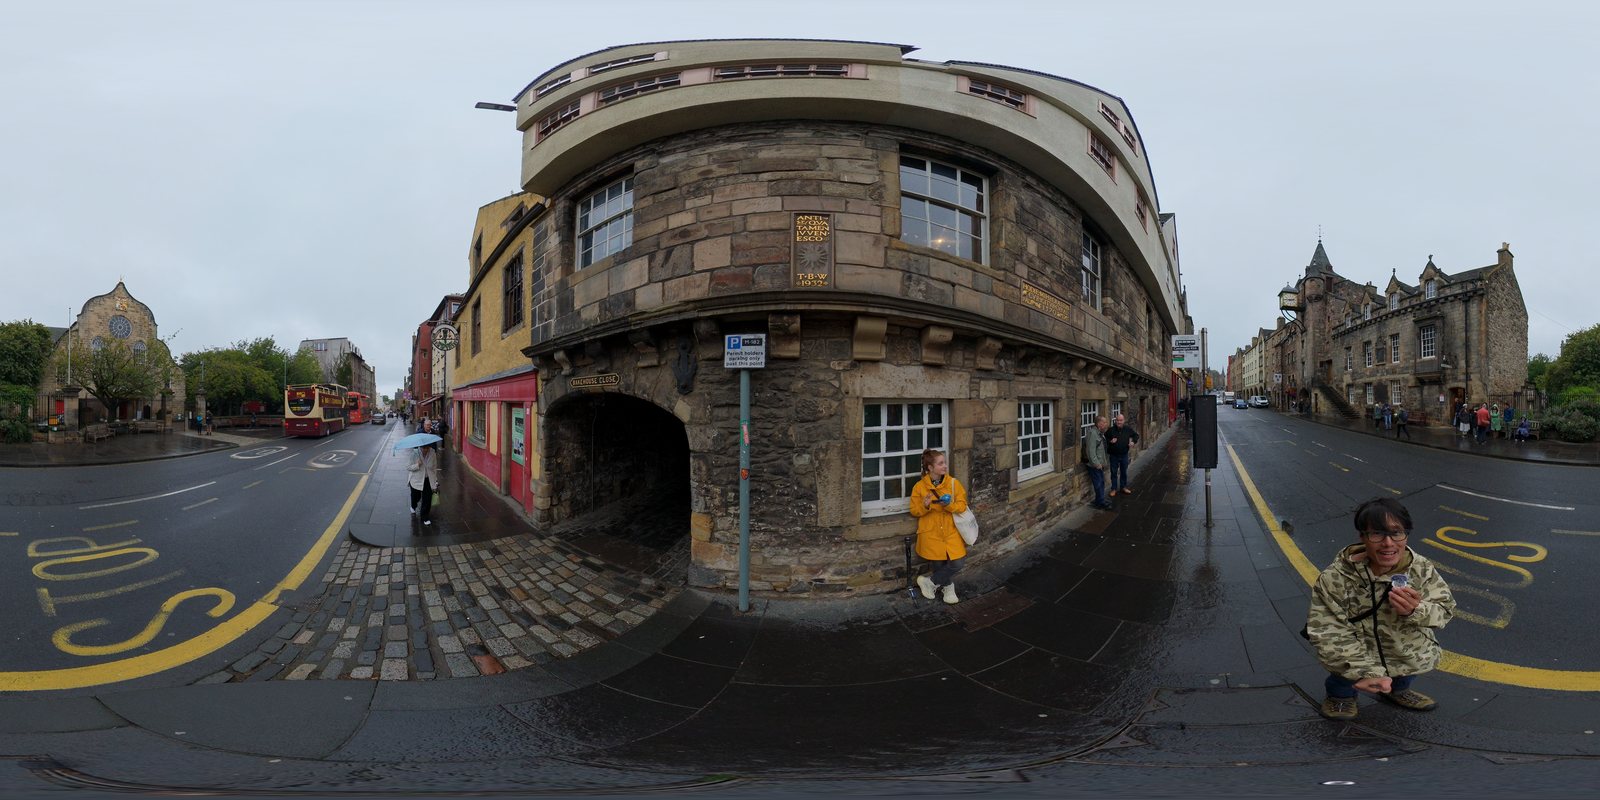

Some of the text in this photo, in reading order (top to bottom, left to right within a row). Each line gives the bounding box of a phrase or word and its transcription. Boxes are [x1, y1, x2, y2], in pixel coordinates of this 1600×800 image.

[730, 338, 739, 348] P
[473, 385, 500, 398] EDINBURGH
[27, 536, 236, 656] STOP
